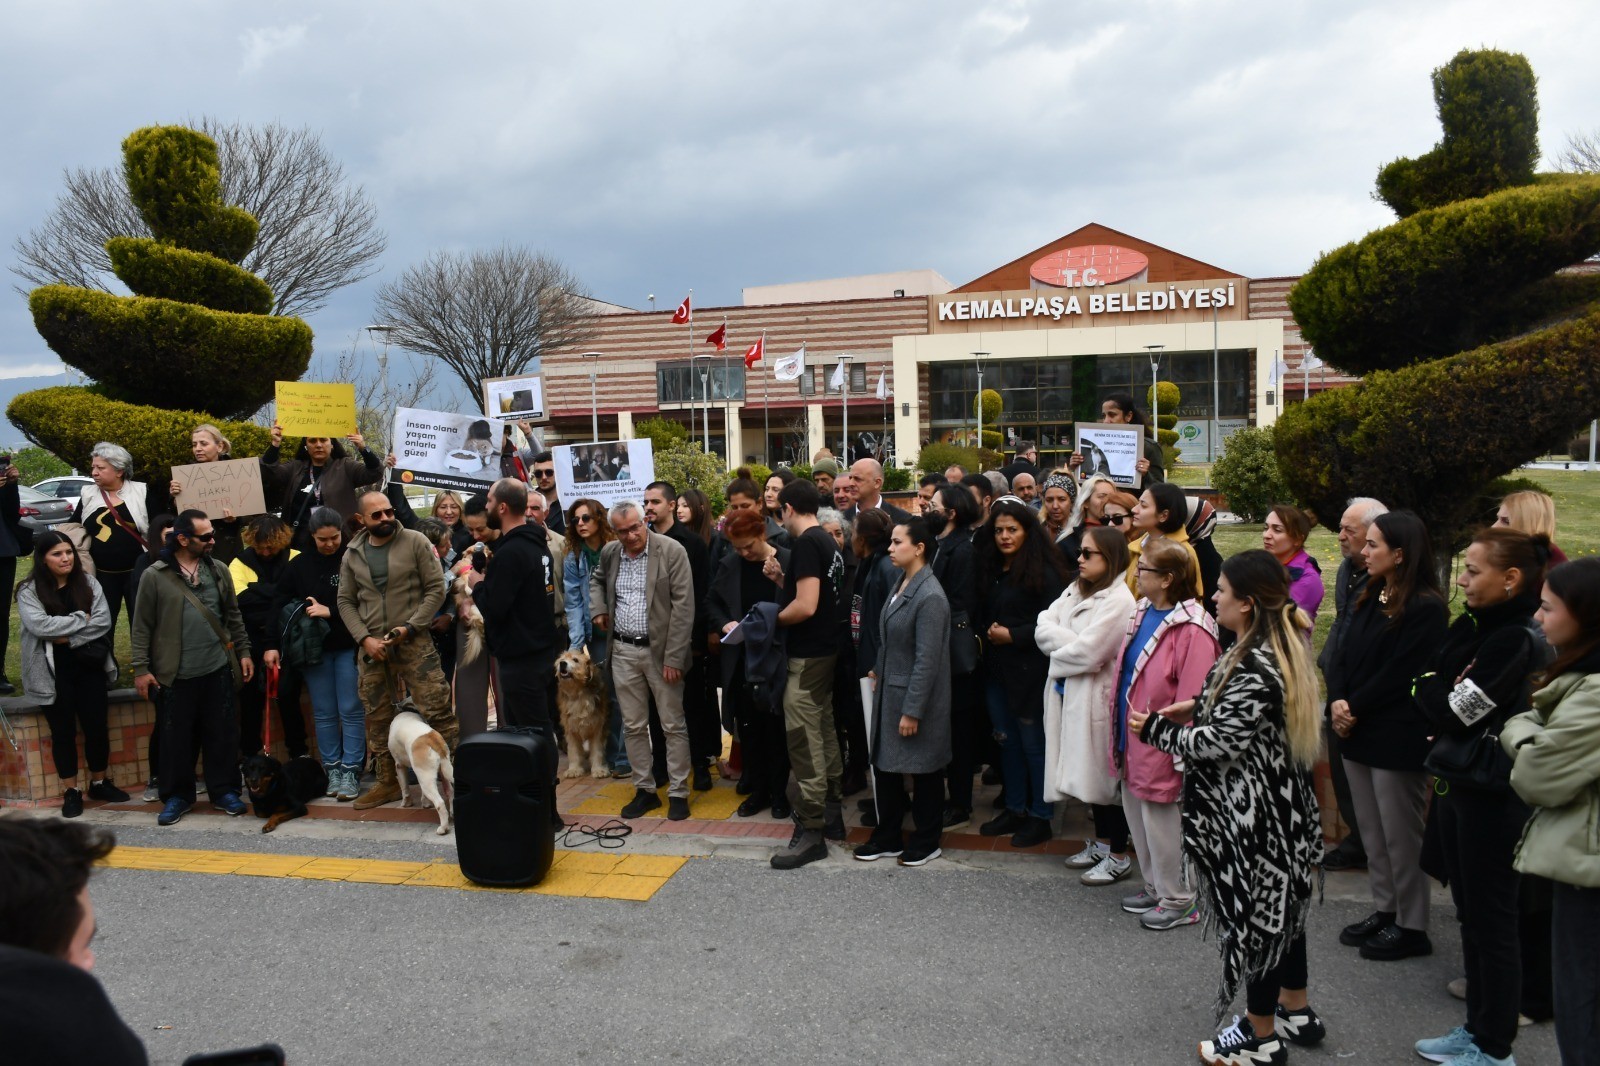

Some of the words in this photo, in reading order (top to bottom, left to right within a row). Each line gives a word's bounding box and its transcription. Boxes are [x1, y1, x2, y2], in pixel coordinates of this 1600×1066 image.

[1062, 268, 1105, 288] T.C.
[939, 295, 1082, 321] KEMALPAŞA
[1089, 282, 1235, 314] BELEDİYESİ
[432, 424, 458, 434] olana
[405, 430, 436, 441] yaşam
[405, 440, 436, 449] onlarla
[404, 448, 428, 457] güzel
[414, 475, 436, 483] HALKIN
[436, 478, 467, 488] KURTULUŞ
[620, 480, 636, 488] geldi
[198, 486, 231, 498] HAKKI
[1466, 692, 1486, 711] SPEAK
